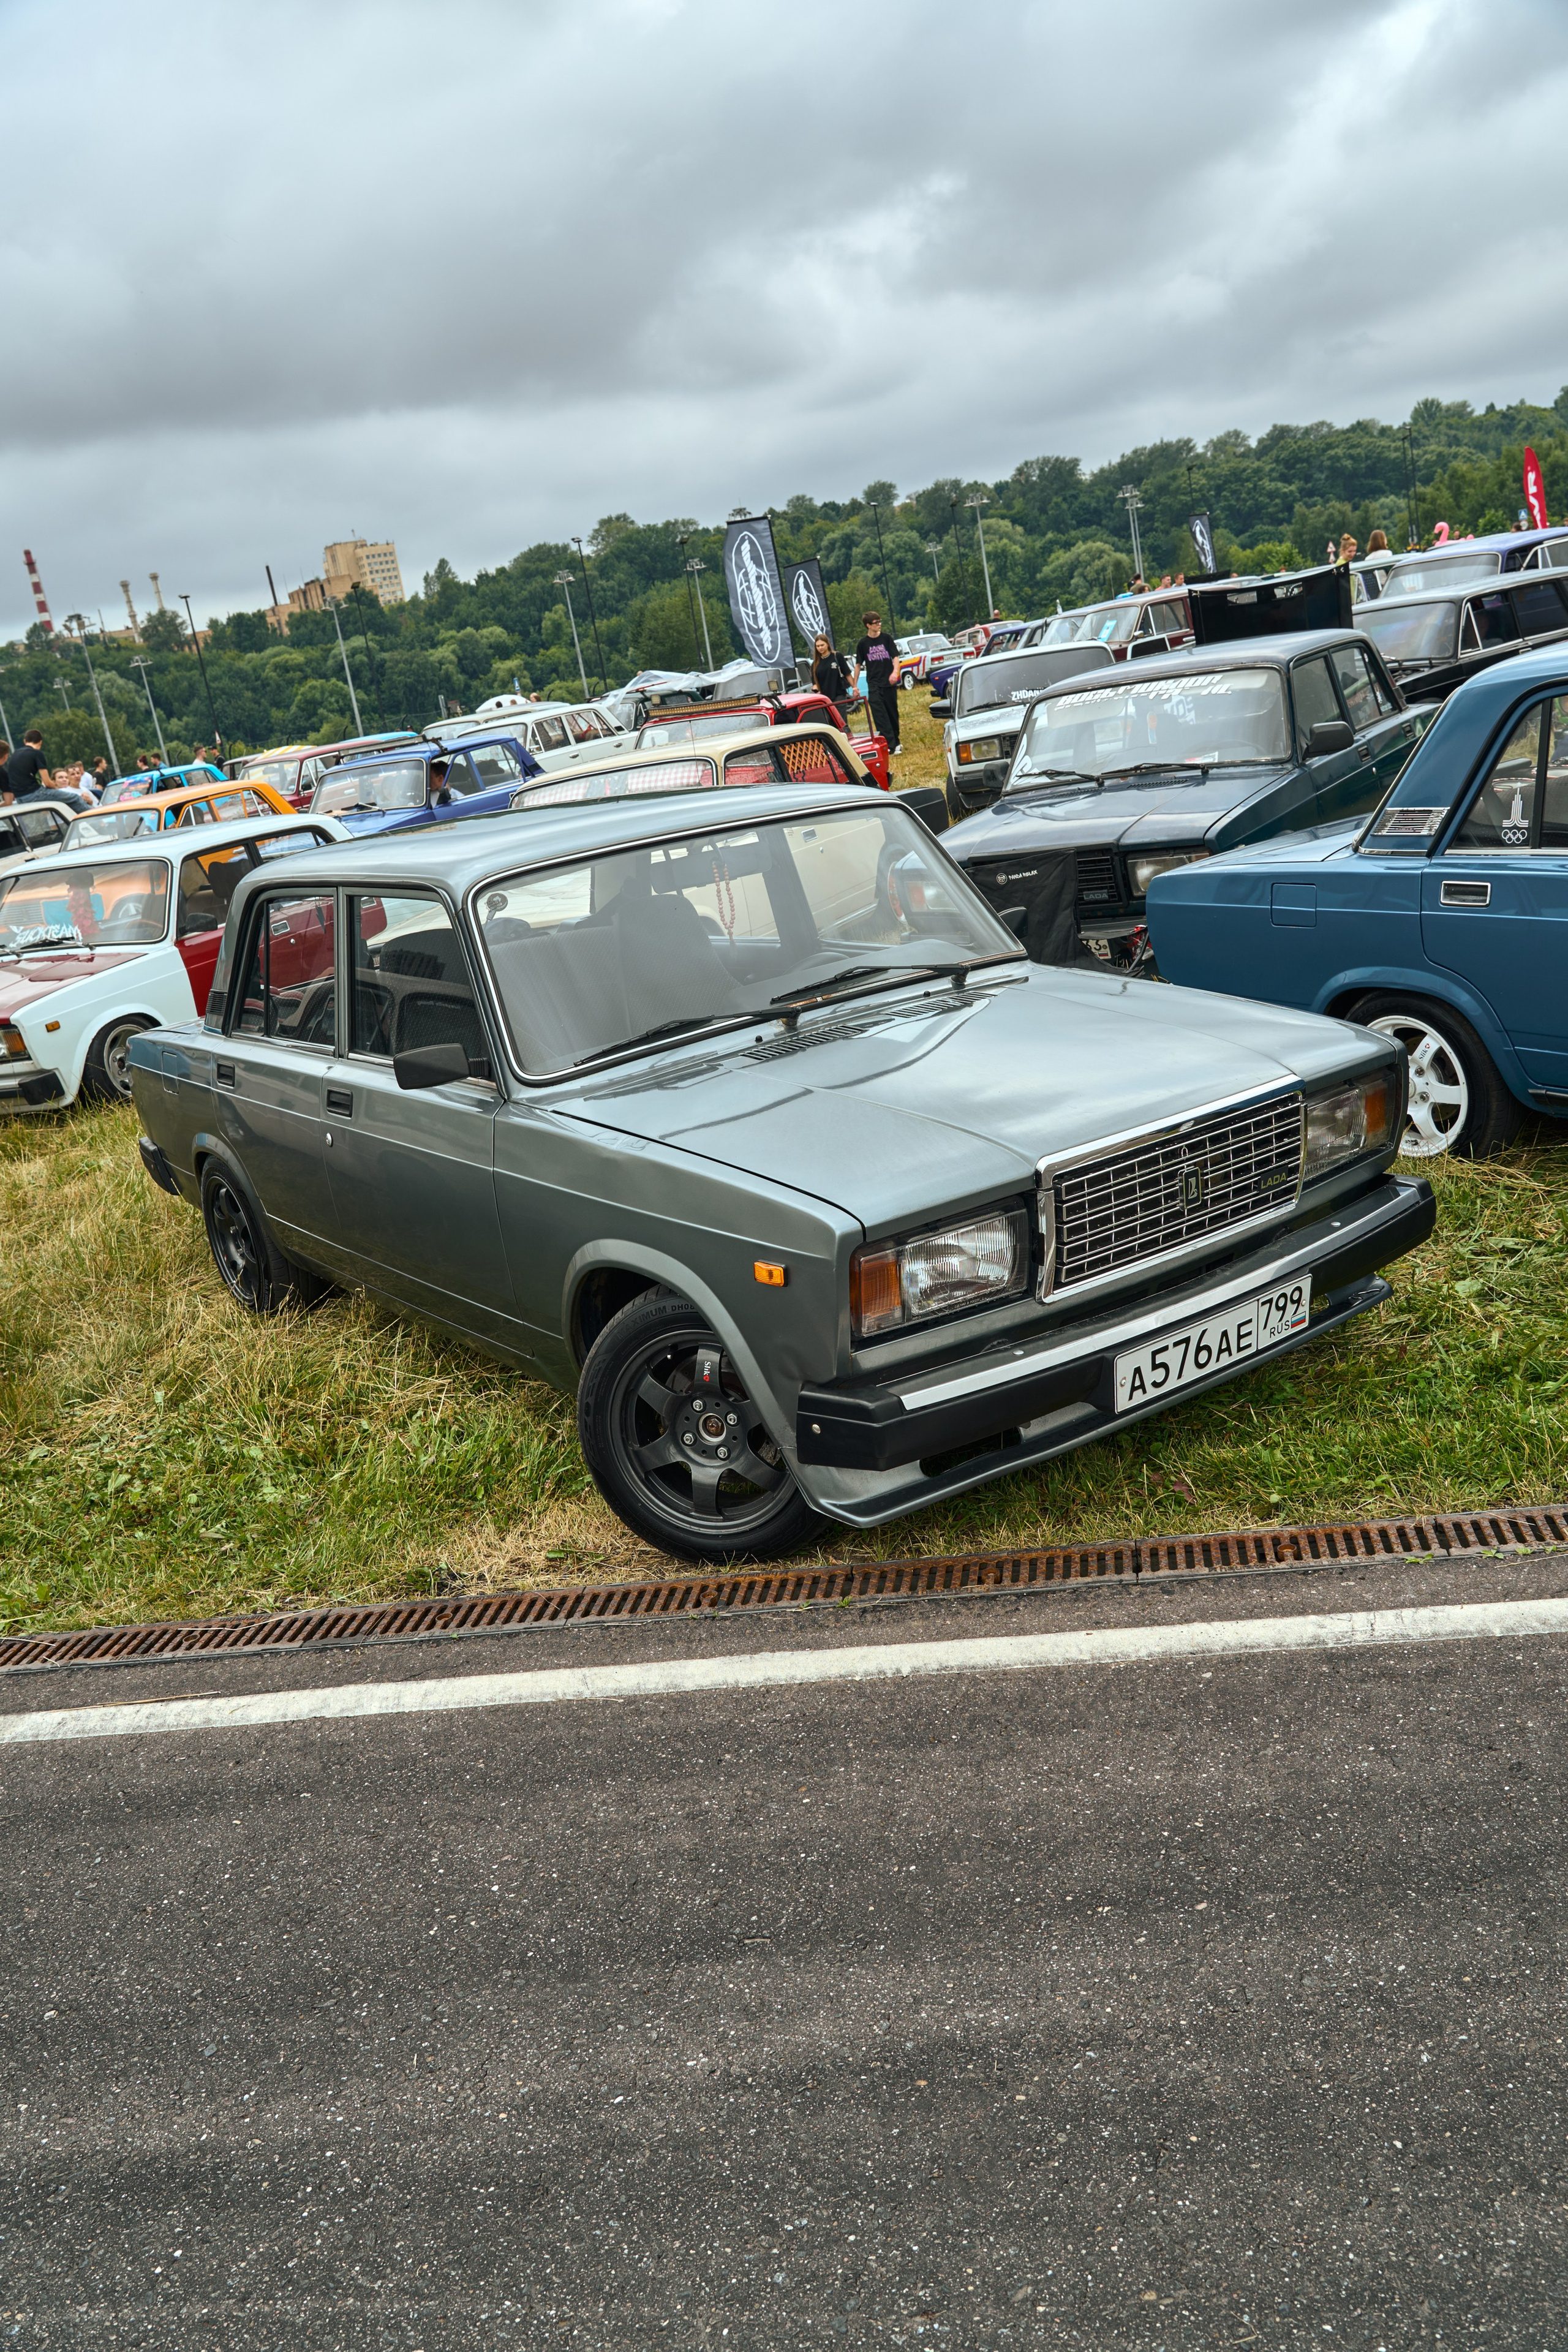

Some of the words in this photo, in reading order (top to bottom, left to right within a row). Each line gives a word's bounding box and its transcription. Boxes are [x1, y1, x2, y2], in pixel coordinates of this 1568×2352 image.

[1261, 1172, 1287, 1189] LADA
[1261, 1286, 1303, 1330] 799
[1270, 1319, 1290, 1338] RUS
